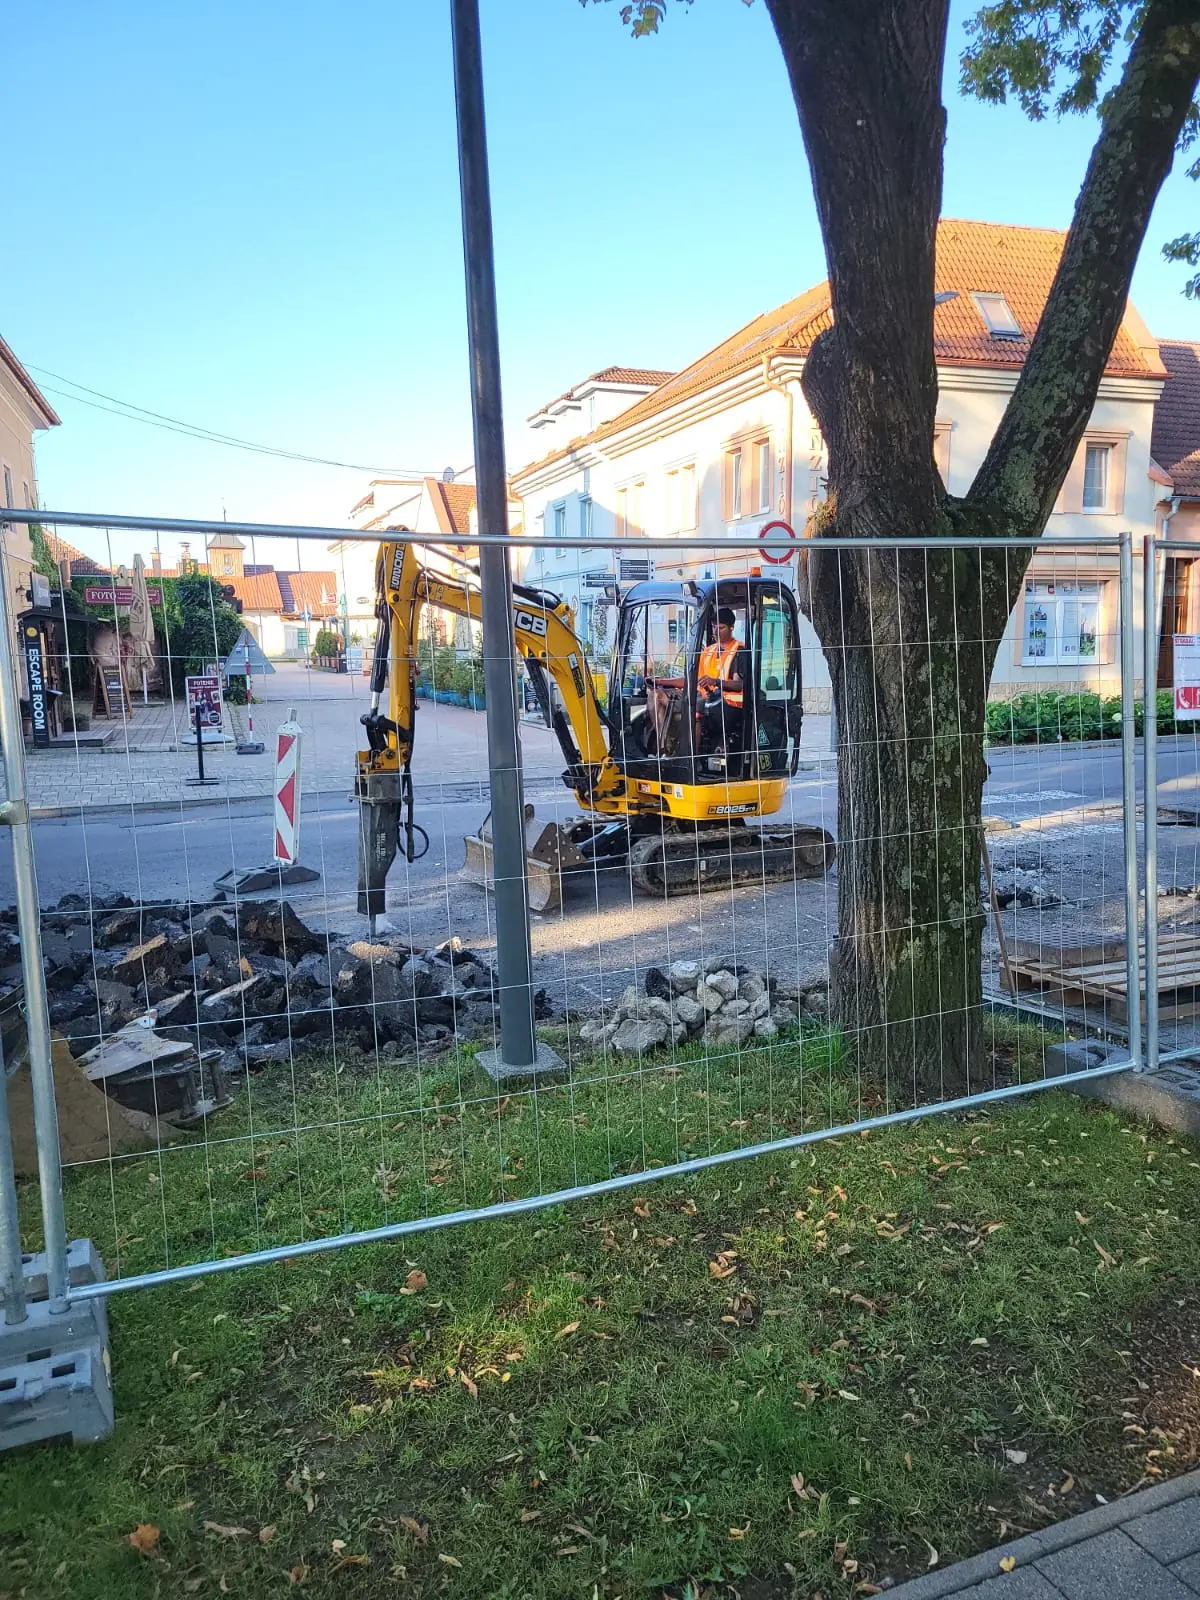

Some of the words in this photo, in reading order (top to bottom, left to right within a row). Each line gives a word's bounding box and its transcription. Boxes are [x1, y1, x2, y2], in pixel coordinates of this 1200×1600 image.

[391, 549, 404, 586] 8025
[91, 591, 117, 600] FOTO
[513, 608, 547, 636] CB
[28, 648, 42, 691] ESCAPE
[33, 695, 45, 730] ROOM
[716, 804, 746, 814] 8025
